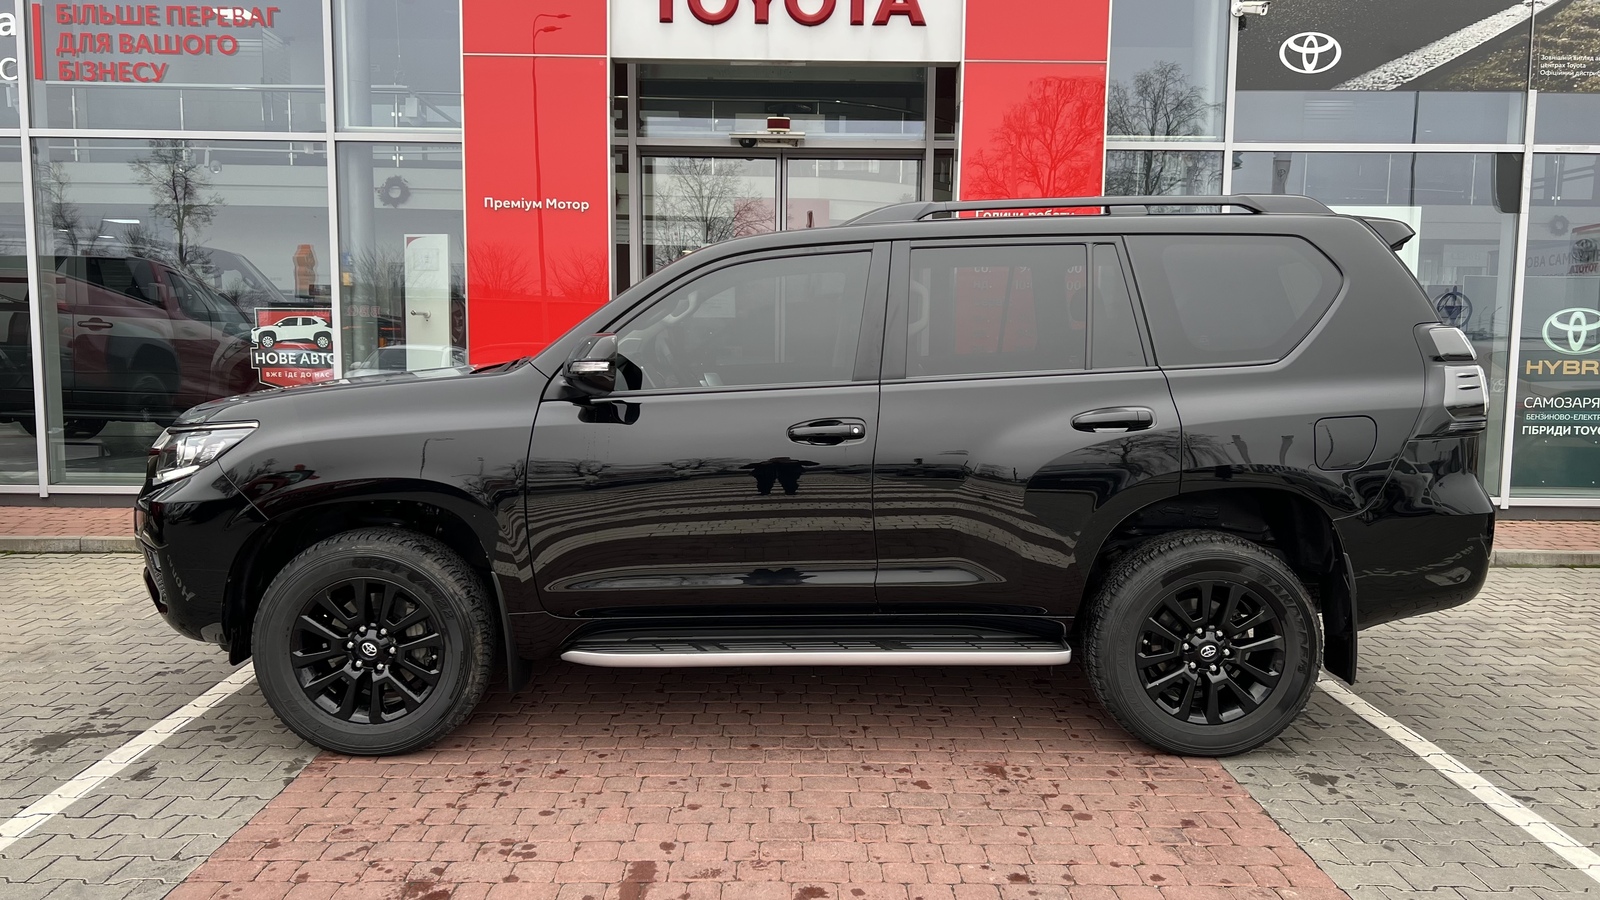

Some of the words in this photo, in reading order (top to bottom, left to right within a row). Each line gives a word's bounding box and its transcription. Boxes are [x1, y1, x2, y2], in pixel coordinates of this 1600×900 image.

[56, 4, 160, 25] БІЛЬШЕ
[166, 6, 280, 27] ПЕРЕВАГ
[56, 32, 111, 56] ДЛЯ
[119, 34, 239, 56] ВАШОГО
[58, 60, 168, 83] БІЗНЕСУ
[483, 197, 542, 211] Преміум
[545, 198, 590, 212] Мотор
[255, 352, 296, 364] НОВЕ
[300, 352, 334, 364] АВТО
[284, 371, 297, 379] ЇДЕ
[1525, 360, 1599, 375] HYBR
[1523, 396, 1600, 409] САМОЗАРЯ
[1522, 425, 1571, 437] ГІБРИДИ
[1573, 425, 1600, 435] TOY
